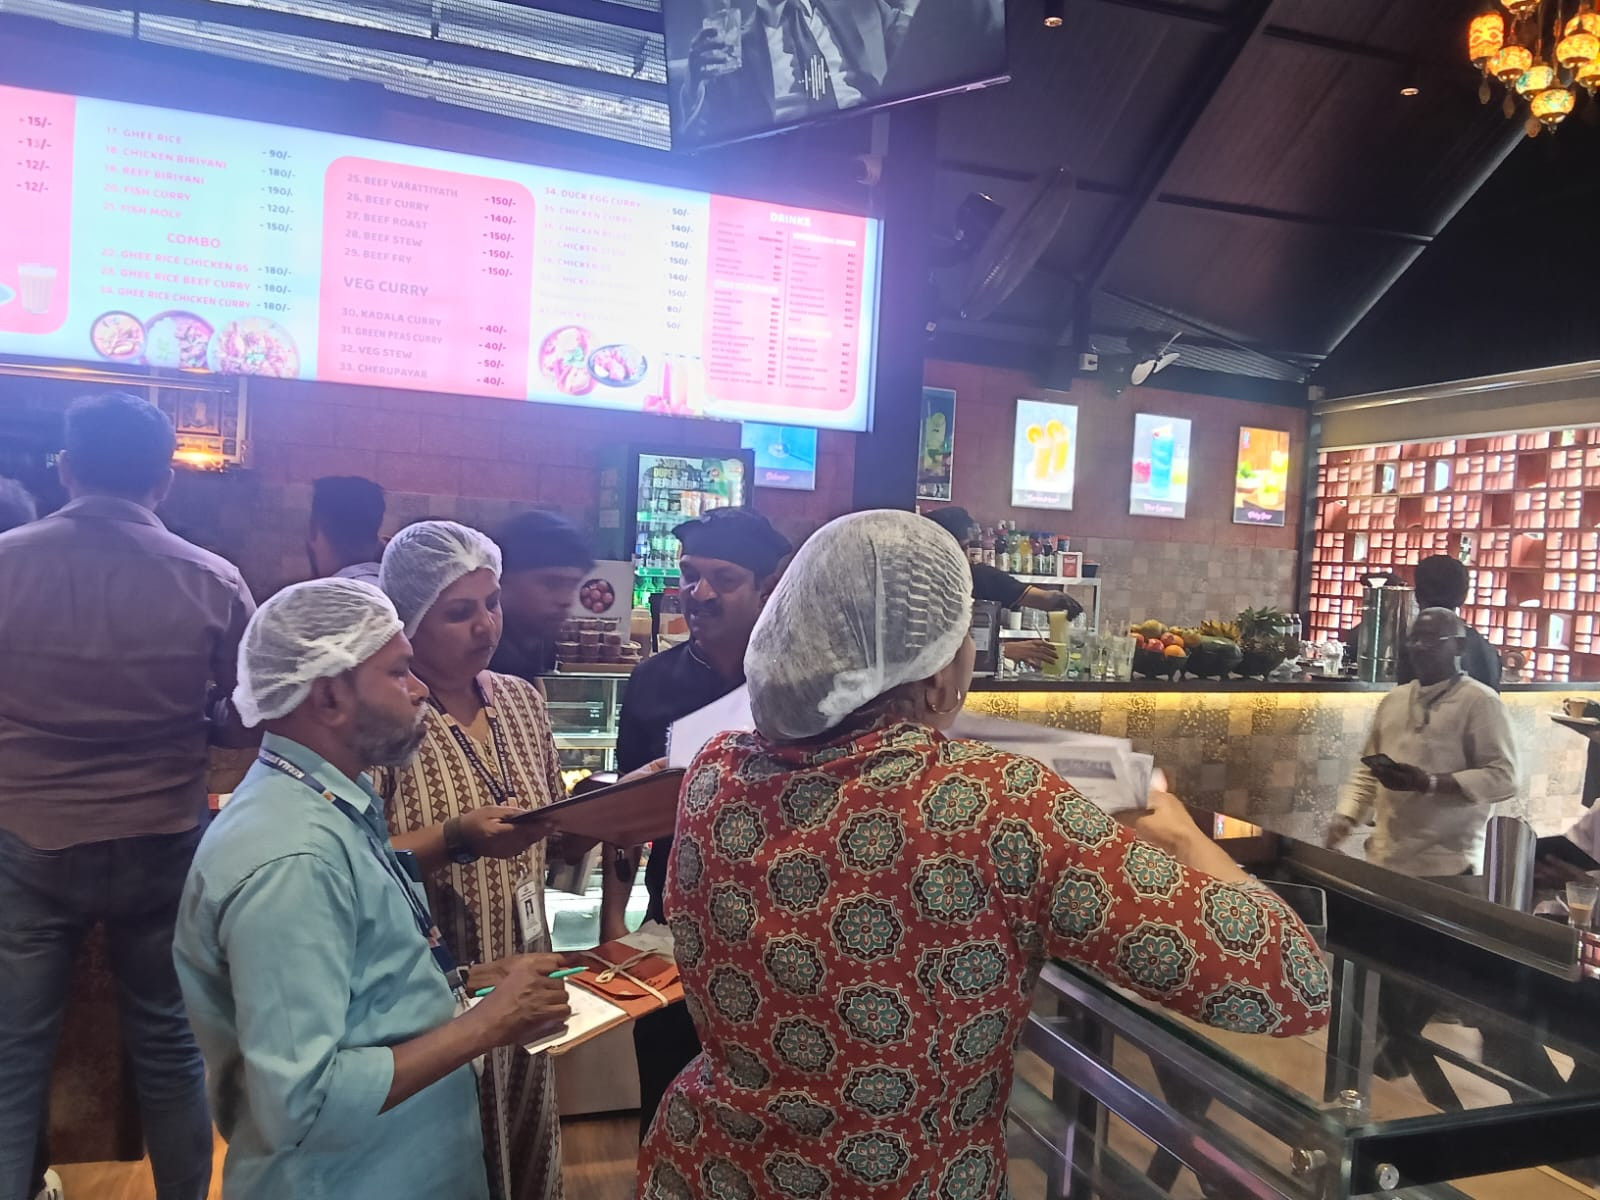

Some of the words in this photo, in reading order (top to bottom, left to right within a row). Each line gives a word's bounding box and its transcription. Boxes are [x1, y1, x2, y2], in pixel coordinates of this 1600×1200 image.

[123, 129, 153, 140] GHEE
[157, 134, 182, 144] RICE
[123, 148, 173, 161] CHICKEN
[176, 155, 228, 169] BIRIYANI
[122, 166, 151, 176] BEEF
[154, 171, 205, 184] BIRIYANI
[364, 176, 389, 187] BEEF
[124, 185, 150, 196] FISH
[153, 189, 192, 201] CURRY
[365, 195, 391, 207] BEEF
[394, 199, 429, 212] CURRY
[364, 213, 390, 225] BEEF
[392, 217, 428, 230] ROAST
[770, 212, 811, 227] DRINKS
[167, 233, 221, 248] COMBO
[364, 231, 390, 243] BEEF
[393, 236, 423, 247] STEW
[155, 254, 180, 264] RICE
[183, 257, 232, 271] CHICKEN
[363, 250, 389, 261] BEEF
[392, 254, 412, 264] FRY
[154, 272, 179, 283] RICE
[183, 275, 211, 287] BEEF
[214, 280, 251, 291] CURRY
[343, 276, 375, 290] VEG
[378, 281, 429, 297] CURRY
[148, 291, 170, 300] RICE
[173, 294, 216, 307] CHICKEN
[219, 299, 251, 309] CURRY
[361, 310, 404, 323] KADALA
[407, 315, 442, 327] CURRY
[355, 328, 386, 340] GREEN
[388, 331, 411, 341] PEAS
[413, 333, 443, 344] CURRY
[358, 346, 380, 356] VEG
[382, 349, 412, 359] STEW
